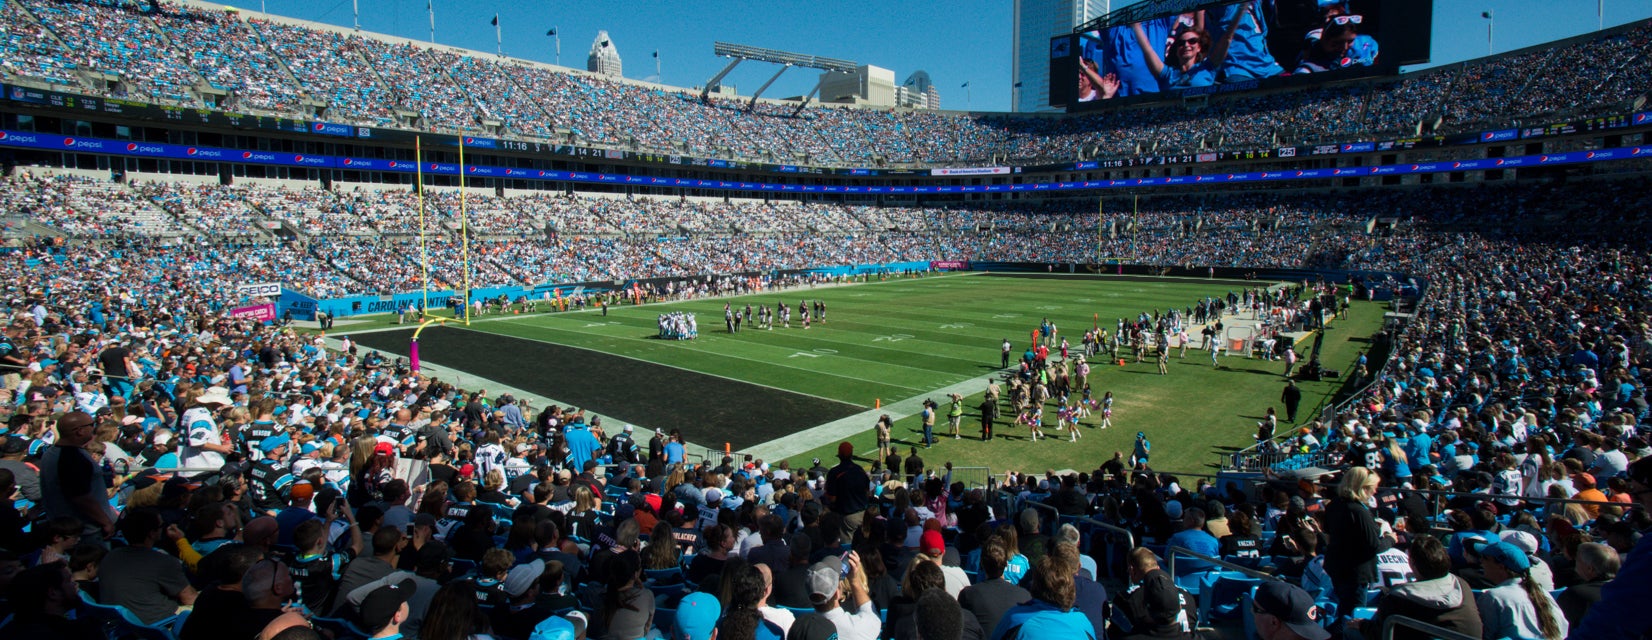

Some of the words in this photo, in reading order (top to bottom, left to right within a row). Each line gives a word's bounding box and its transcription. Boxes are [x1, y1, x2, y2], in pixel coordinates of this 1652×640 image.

[10, 135, 36, 143] pepsi
[1494, 131, 1513, 139] pepsi
[77, 139, 101, 149] pepsi
[140, 144, 163, 153] pepsi
[503, 141, 527, 151] 11:16
[578, 148, 588, 156] 14
[199, 149, 220, 157] pepsi
[254, 152, 274, 161] pepsi
[1281, 148, 1294, 156] 25
[305, 156, 324, 164] pepsi
[354, 159, 371, 167] pepsi
[439, 164, 455, 172] pepsi
[239, 284, 279, 296] GEICO
[368, 298, 414, 313] CAROLINA
[447, 507, 469, 518] NEWTON
[572, 521, 578, 536] 1
[598, 532, 618, 548] PEPPER
[1377, 553, 1409, 565] UECHL
